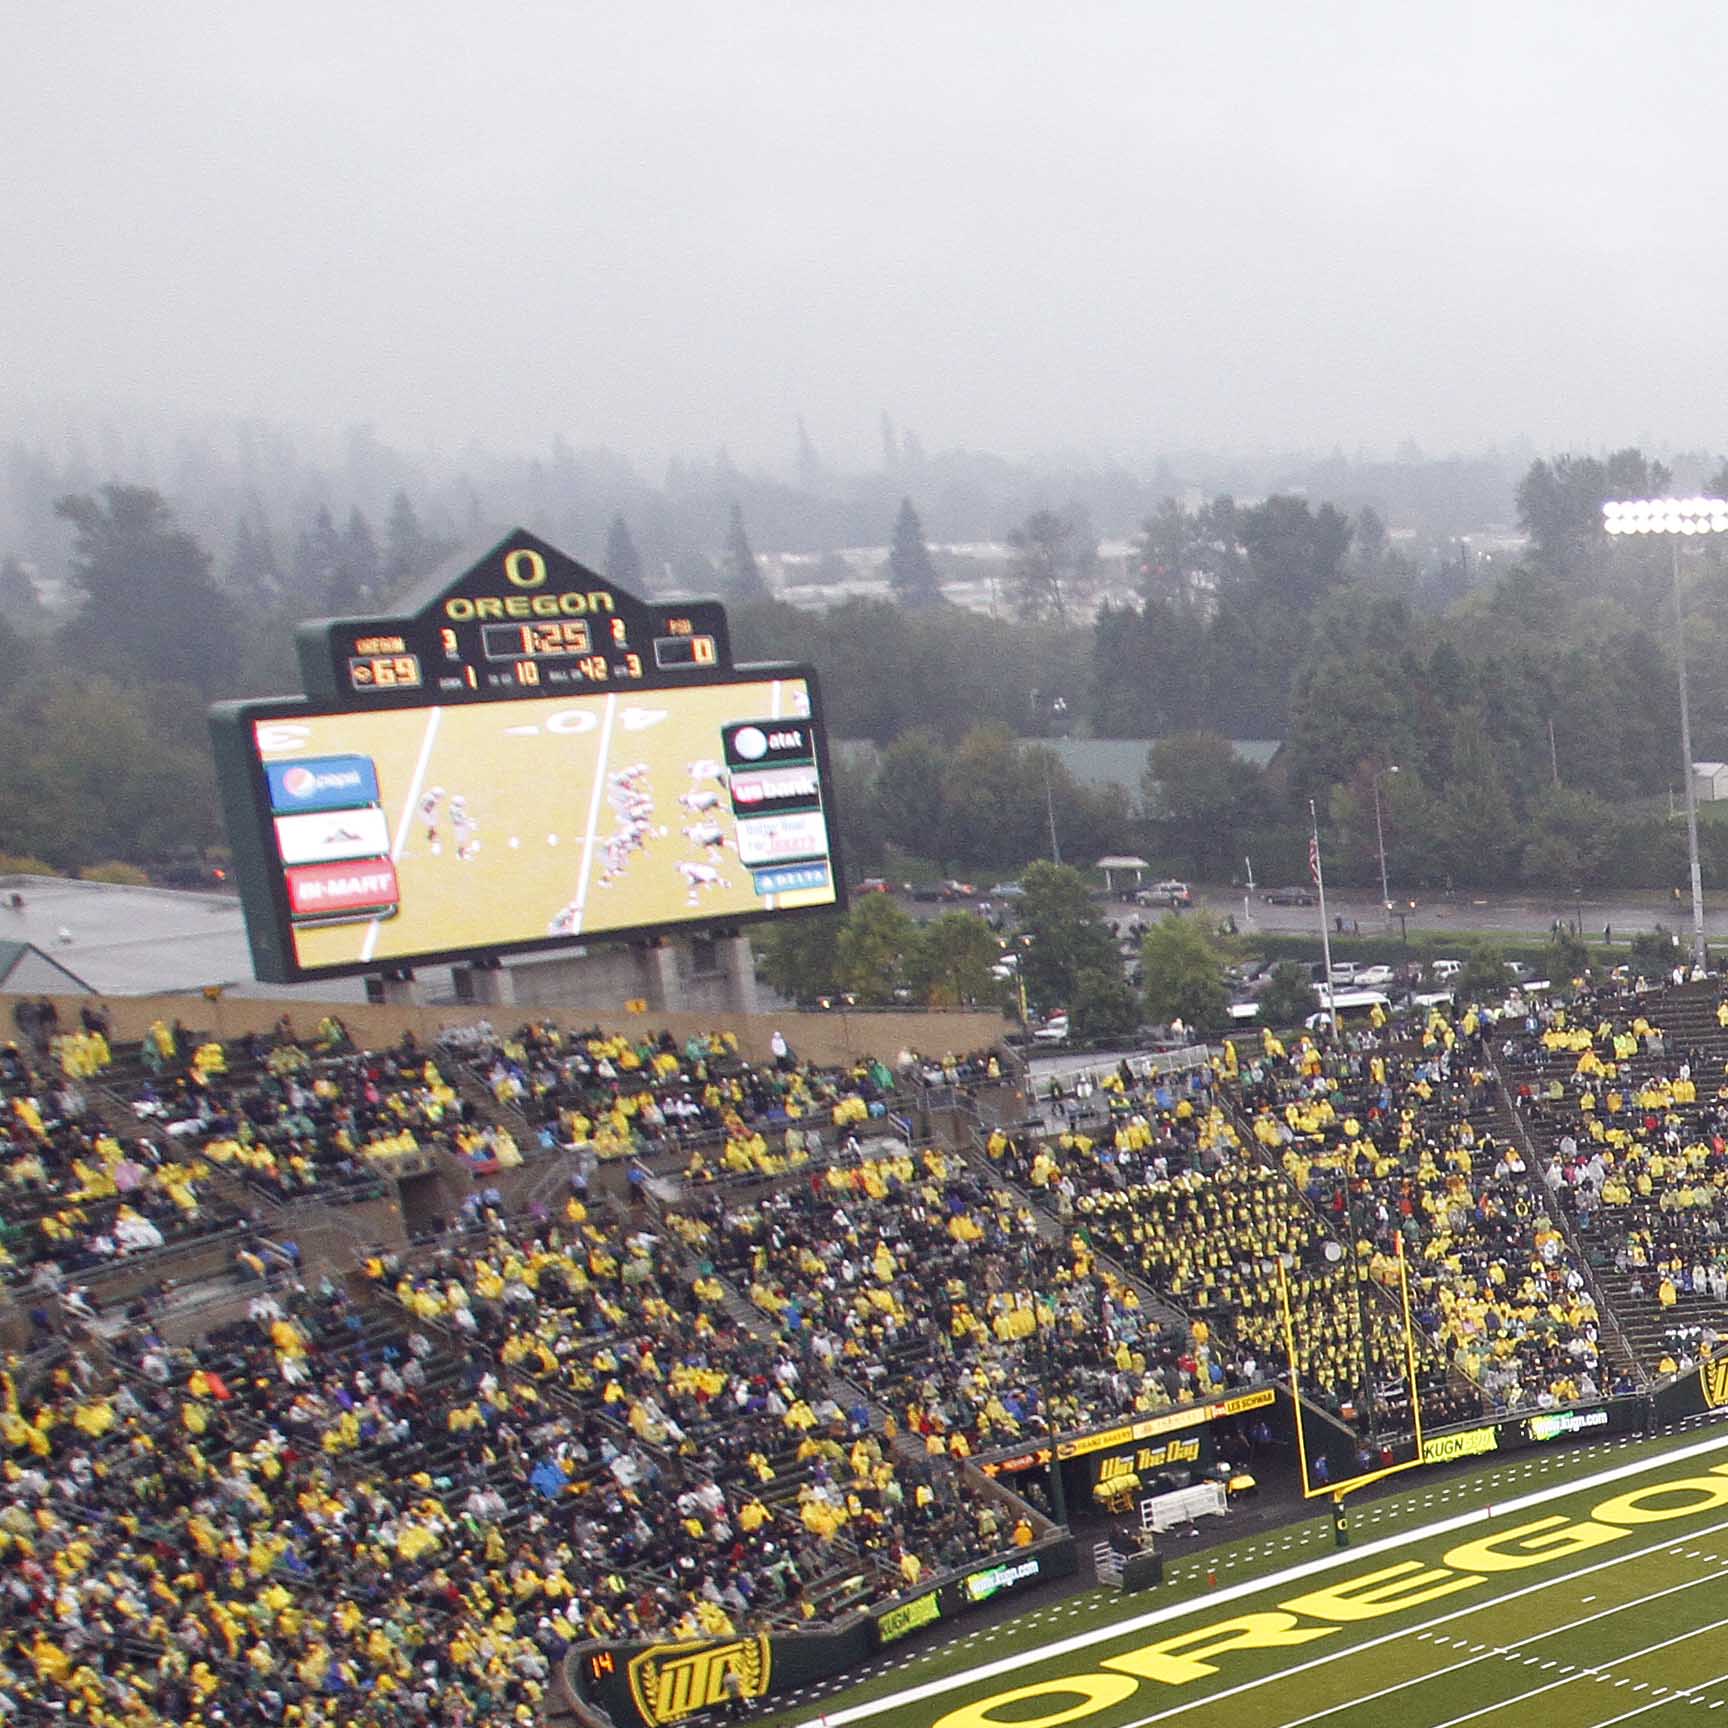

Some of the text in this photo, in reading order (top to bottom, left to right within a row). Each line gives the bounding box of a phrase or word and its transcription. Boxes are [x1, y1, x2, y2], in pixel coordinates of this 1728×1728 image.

[505, 549, 547, 587] O
[446, 592, 616, 621] OREGON
[520, 625, 588, 655] 1:25
[370, 659, 418, 685] 69
[1536, 1411, 1608, 1437] www.kugn.com
[1425, 1440, 1464, 1458] KUGN
[592, 1651, 616, 1679] 14
